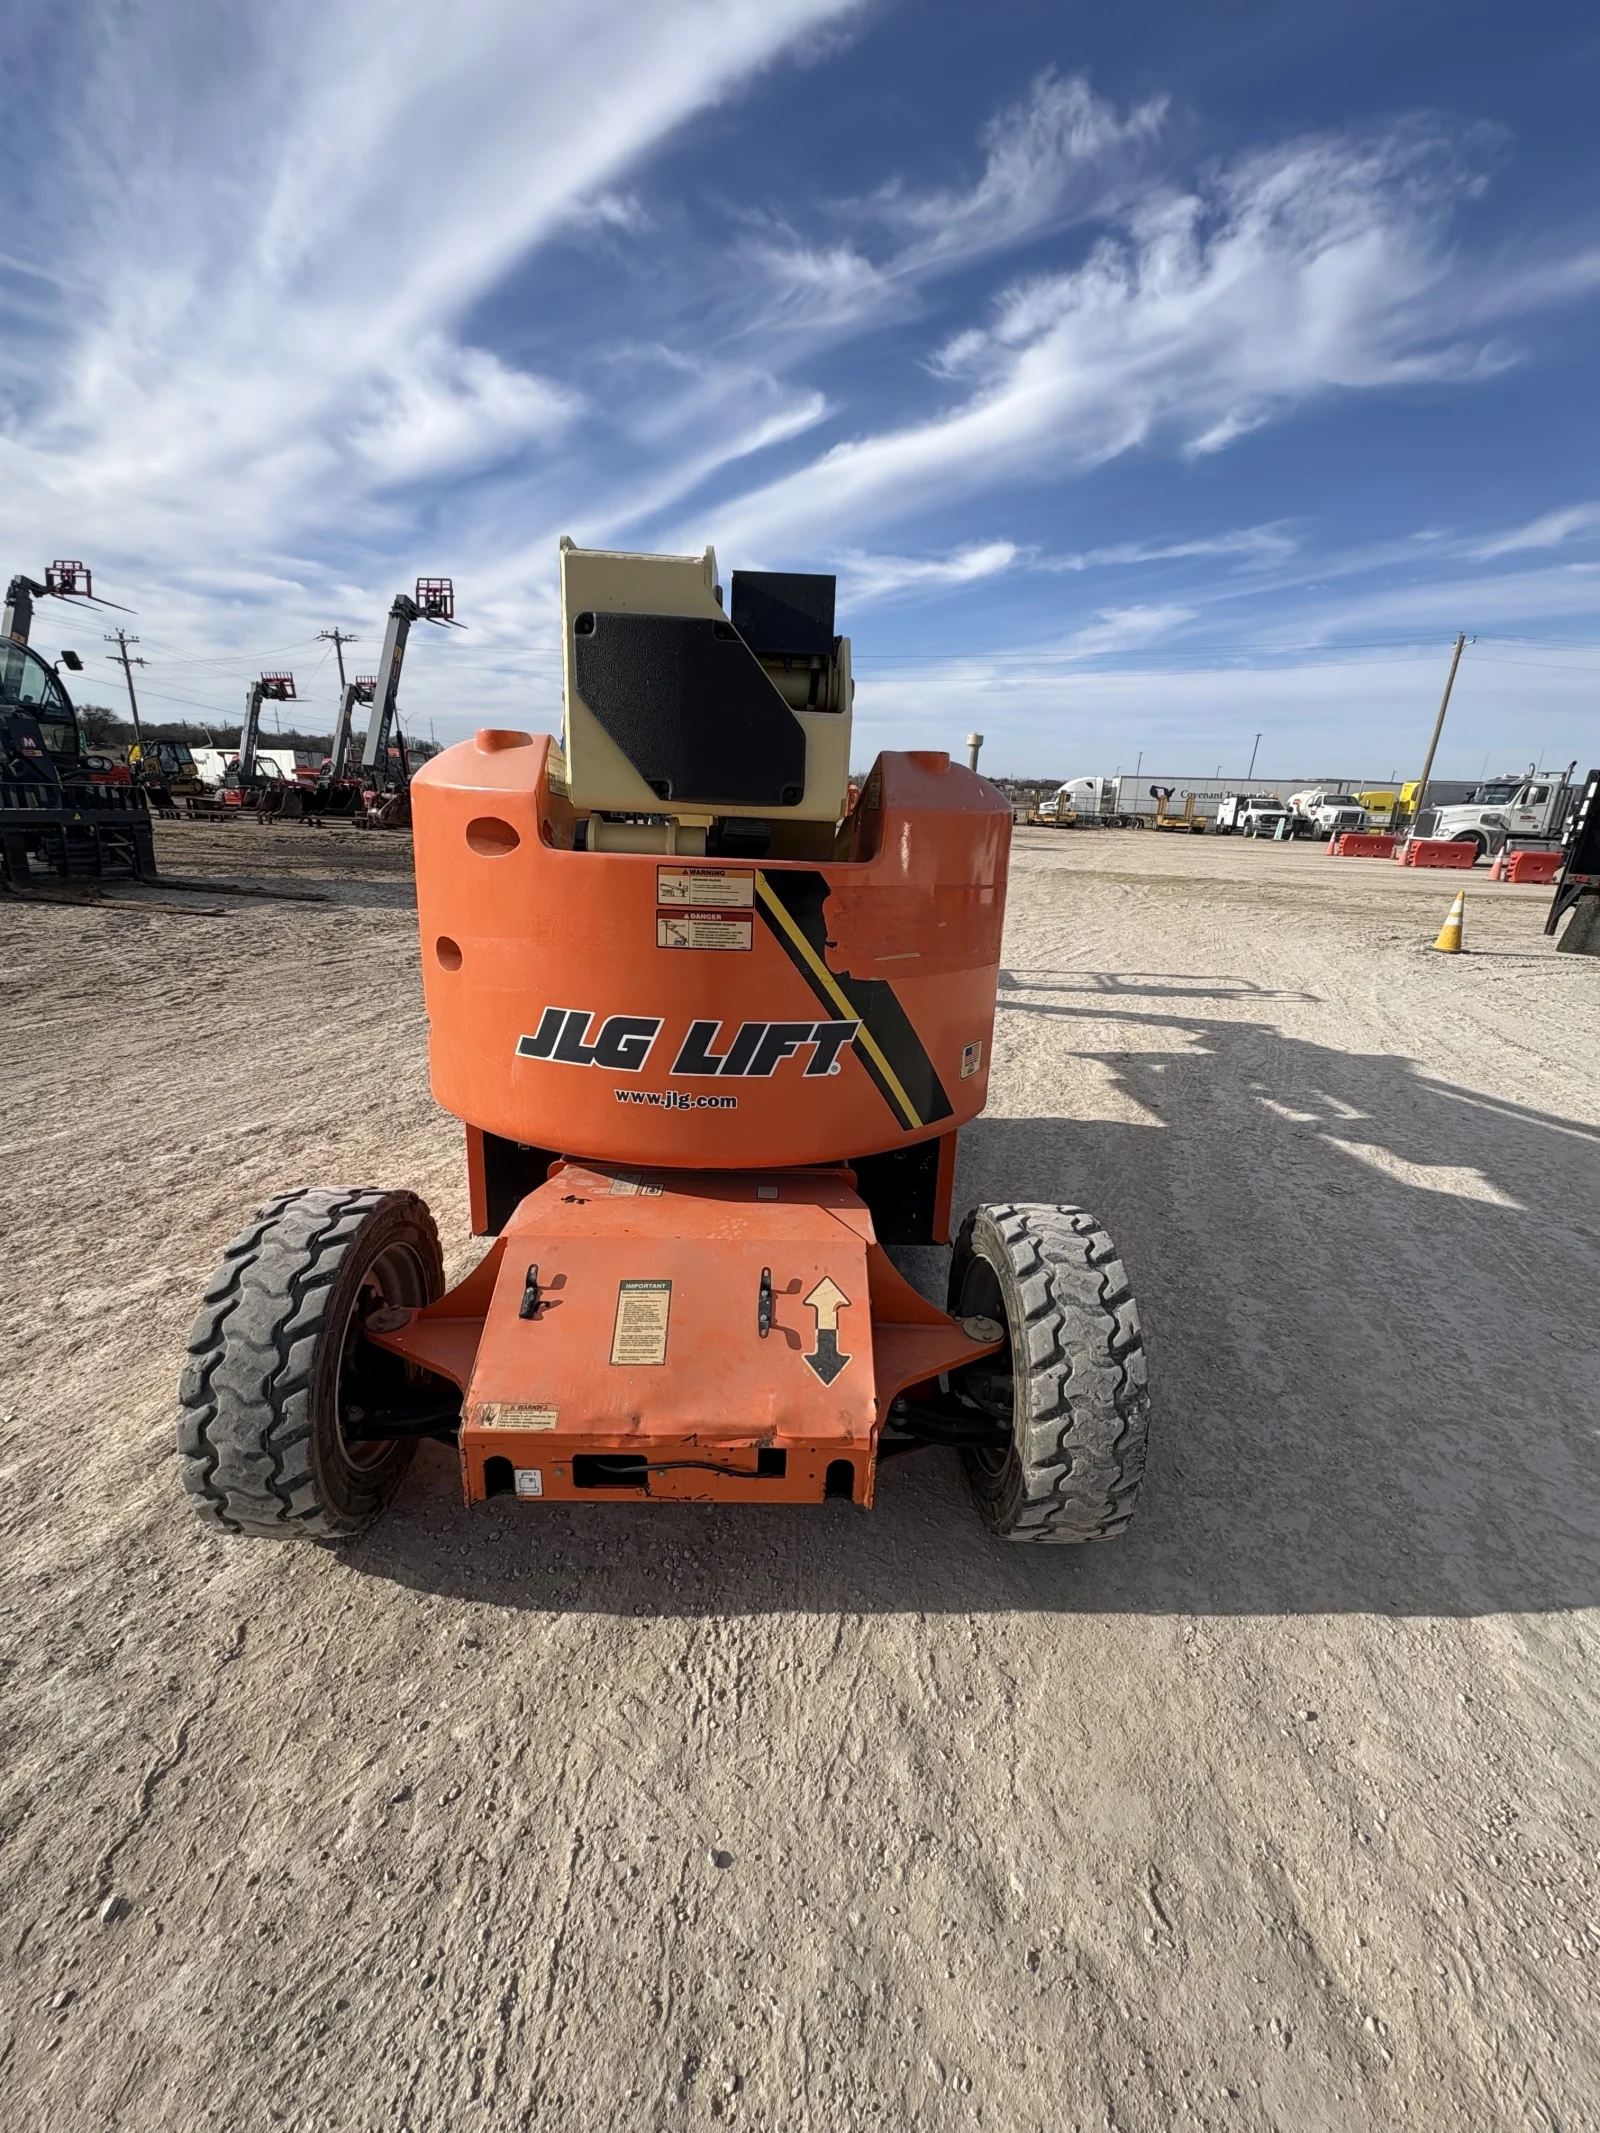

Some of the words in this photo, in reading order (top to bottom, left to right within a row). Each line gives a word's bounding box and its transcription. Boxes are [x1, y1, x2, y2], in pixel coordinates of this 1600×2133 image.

[1180, 789, 1224, 800] Covenant
[689, 868, 726, 877] WARNING
[690, 912, 722, 921] DANGER
[515, 1006, 665, 1072] JLG
[613, 1088, 738, 1110] www.jlg.com
